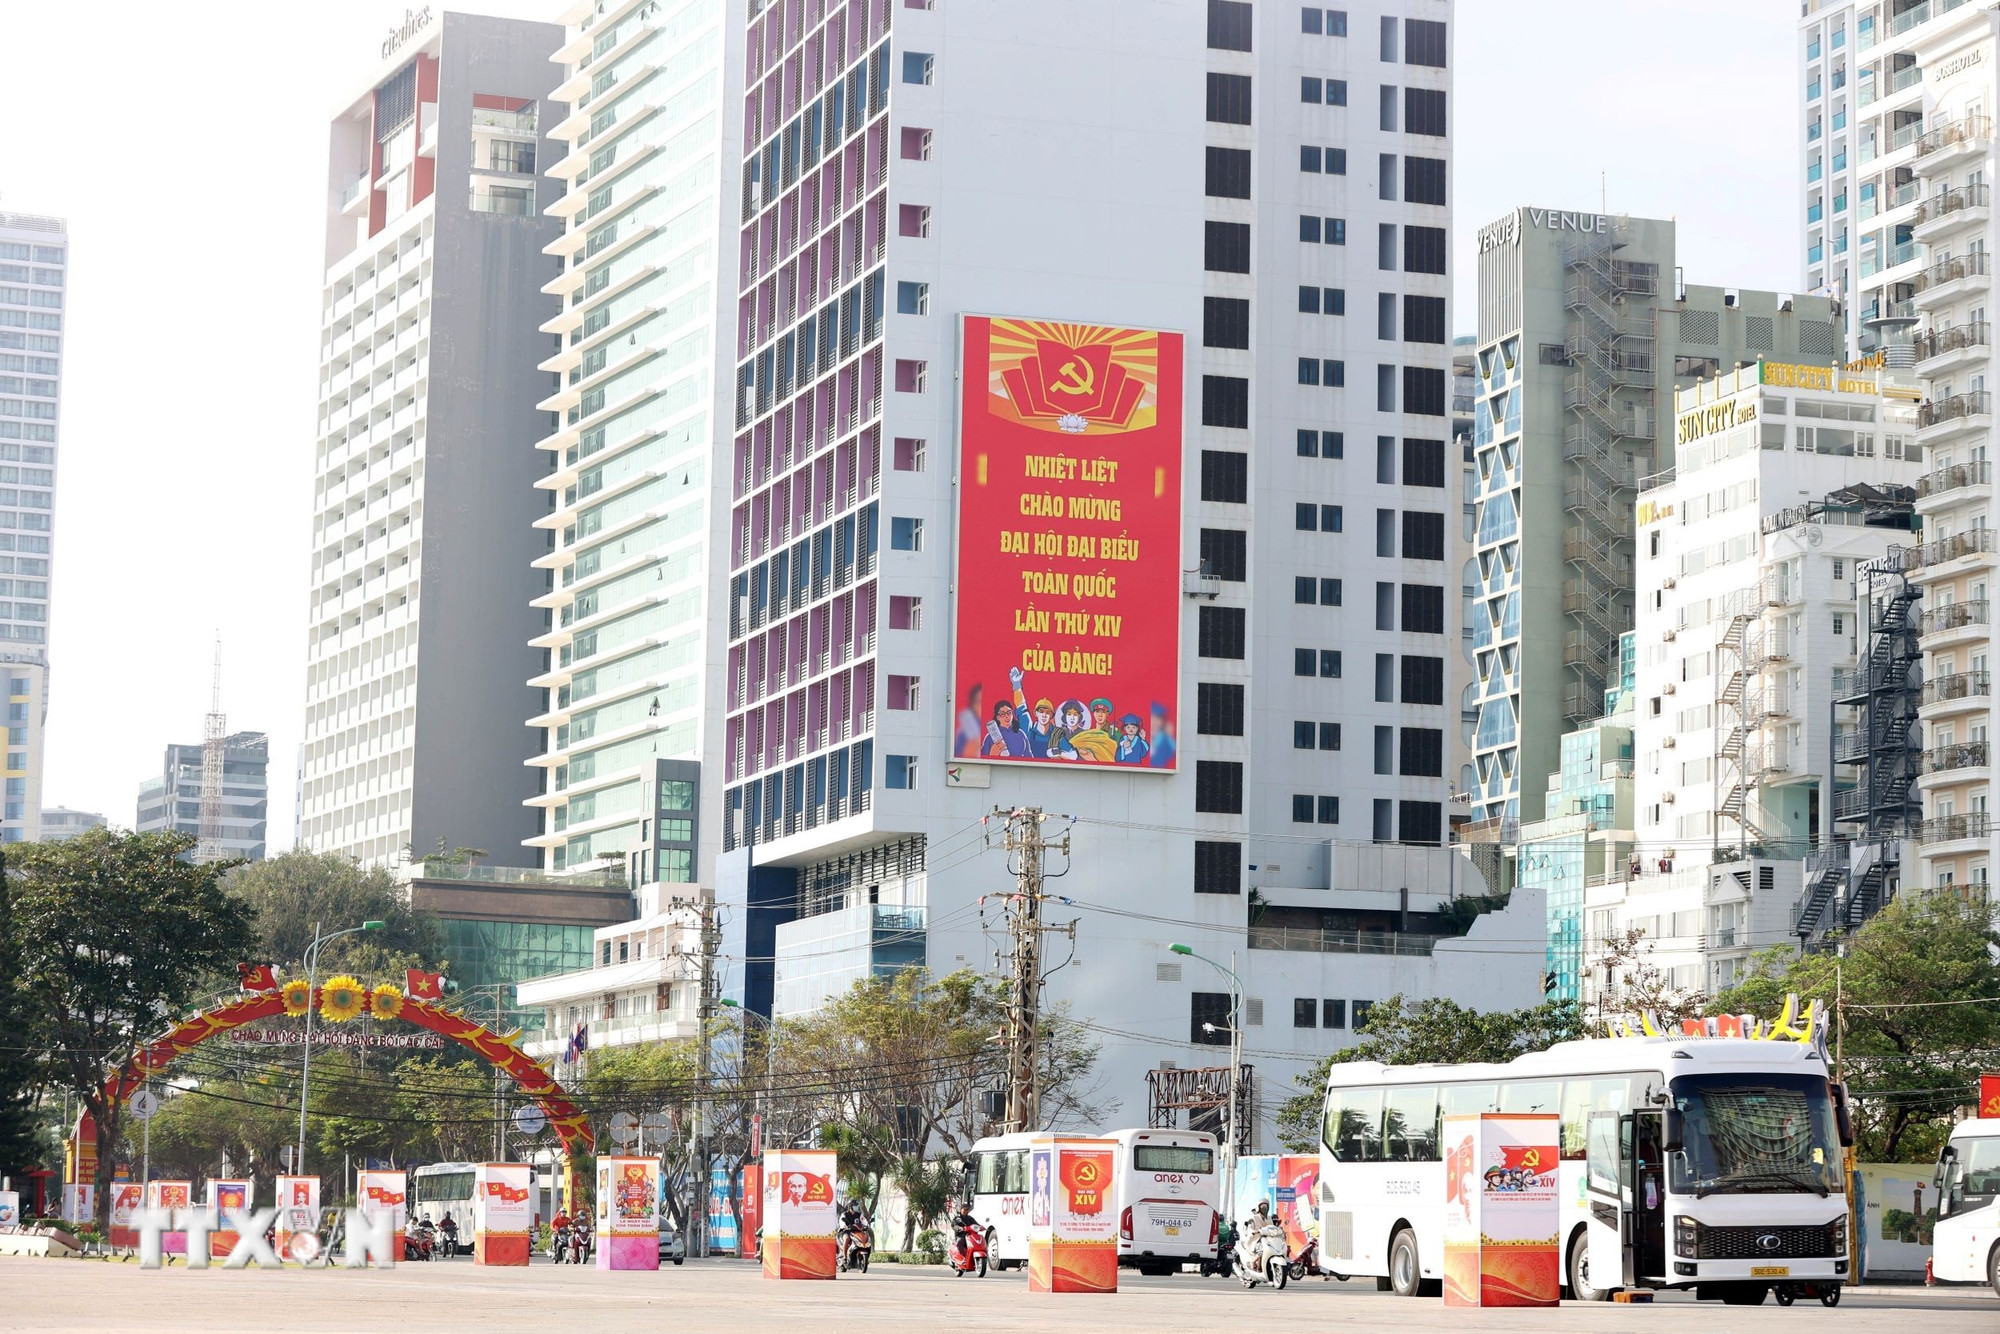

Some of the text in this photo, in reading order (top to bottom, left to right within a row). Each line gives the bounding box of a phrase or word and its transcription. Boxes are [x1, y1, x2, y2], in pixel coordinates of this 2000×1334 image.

[1528, 206, 1606, 235] VENUE
[1477, 222, 1513, 254] VENUE
[1763, 362, 1795, 387] SUN
[1795, 364, 1834, 391] CITY
[1678, 399, 1757, 445] SUN CITY HOTEL
[1025, 452, 1118, 486] NHIỆT LIỆT
[1020, 490, 1121, 522] CHÀO MỪNG
[1000, 529, 1139, 561] ĐẠI HỘI ĐẠI BIỂU
[1022, 568, 1116, 600] TOÀN QUỐC
[1015, 602, 1121, 637] LẦN THỨ XIV
[1022, 643, 1112, 676] CỦA ĐẢNG!
[1154, 1173, 1184, 1184] anex
[1540, 1178, 1556, 1188] XIV
[1002, 1195, 1025, 1215] anex
[1075, 1195, 1096, 1205] XIV
